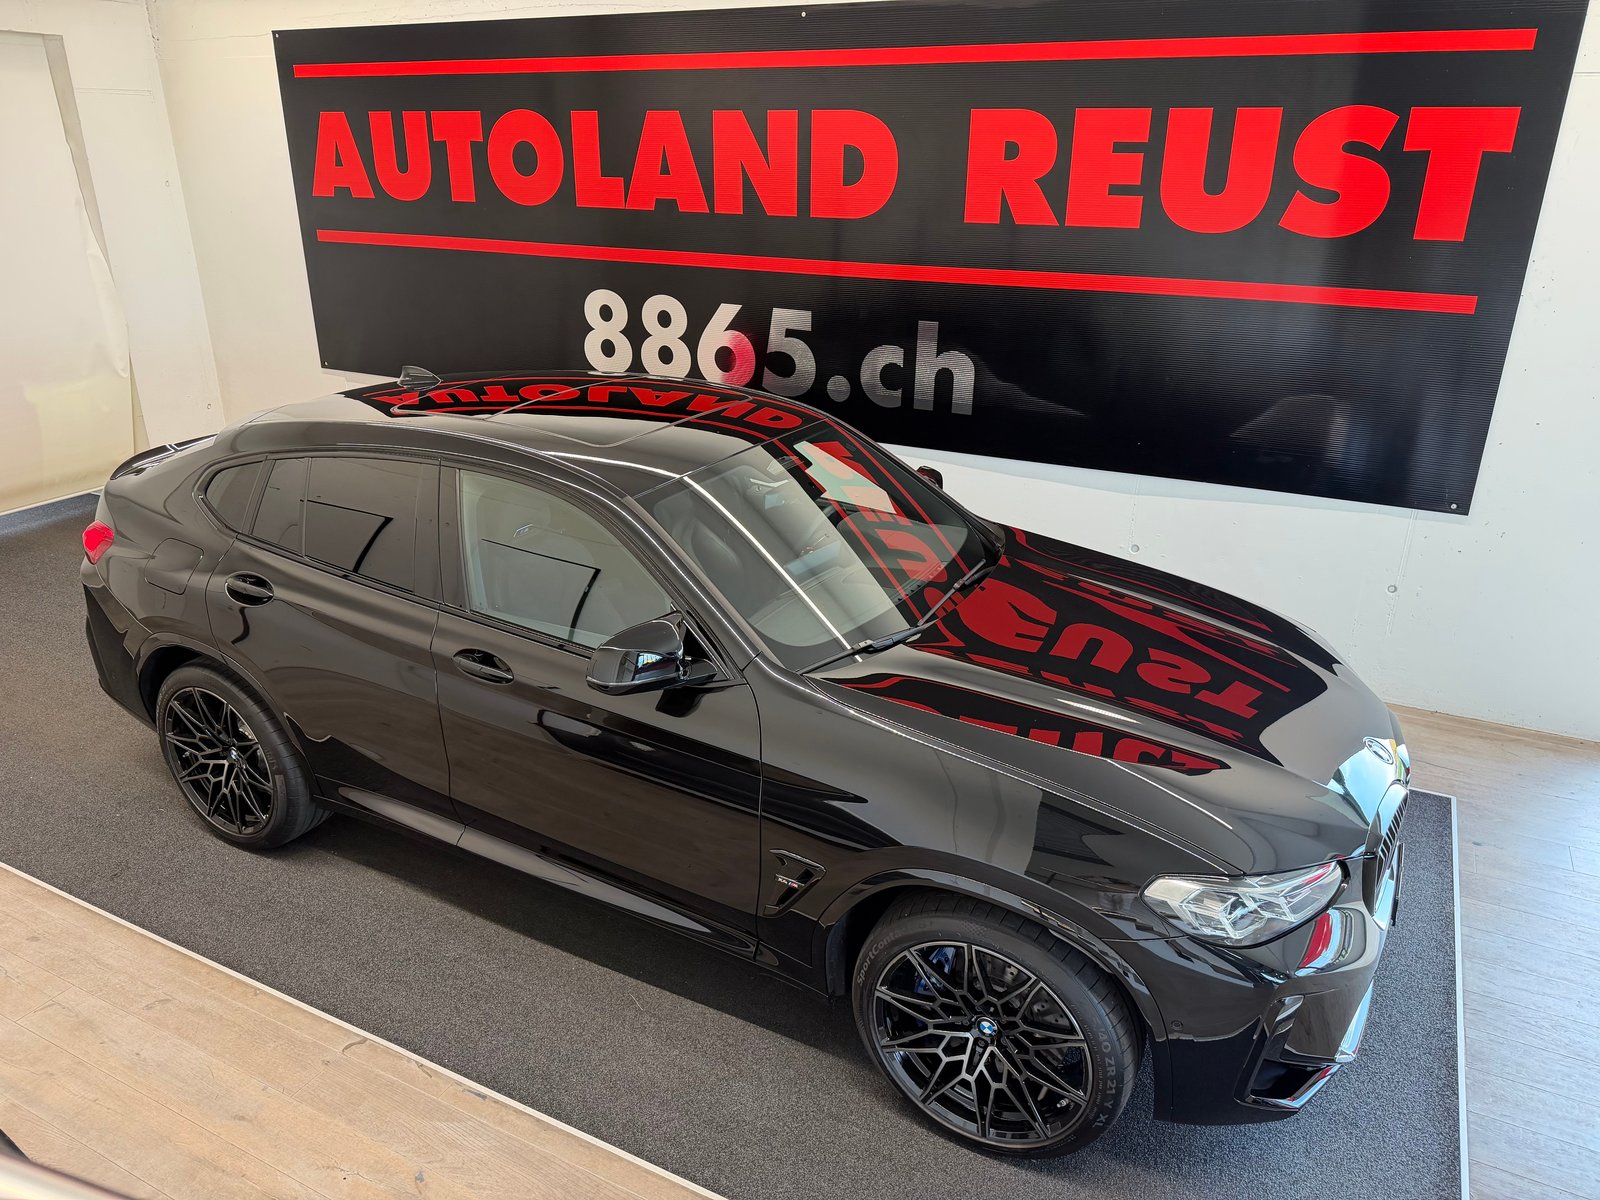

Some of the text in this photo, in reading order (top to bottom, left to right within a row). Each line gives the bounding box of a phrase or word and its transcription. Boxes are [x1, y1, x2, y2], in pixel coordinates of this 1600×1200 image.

[311, 104, 1522, 242] AUTOLAND REUST
[583, 288, 976, 416] 8865.ch
